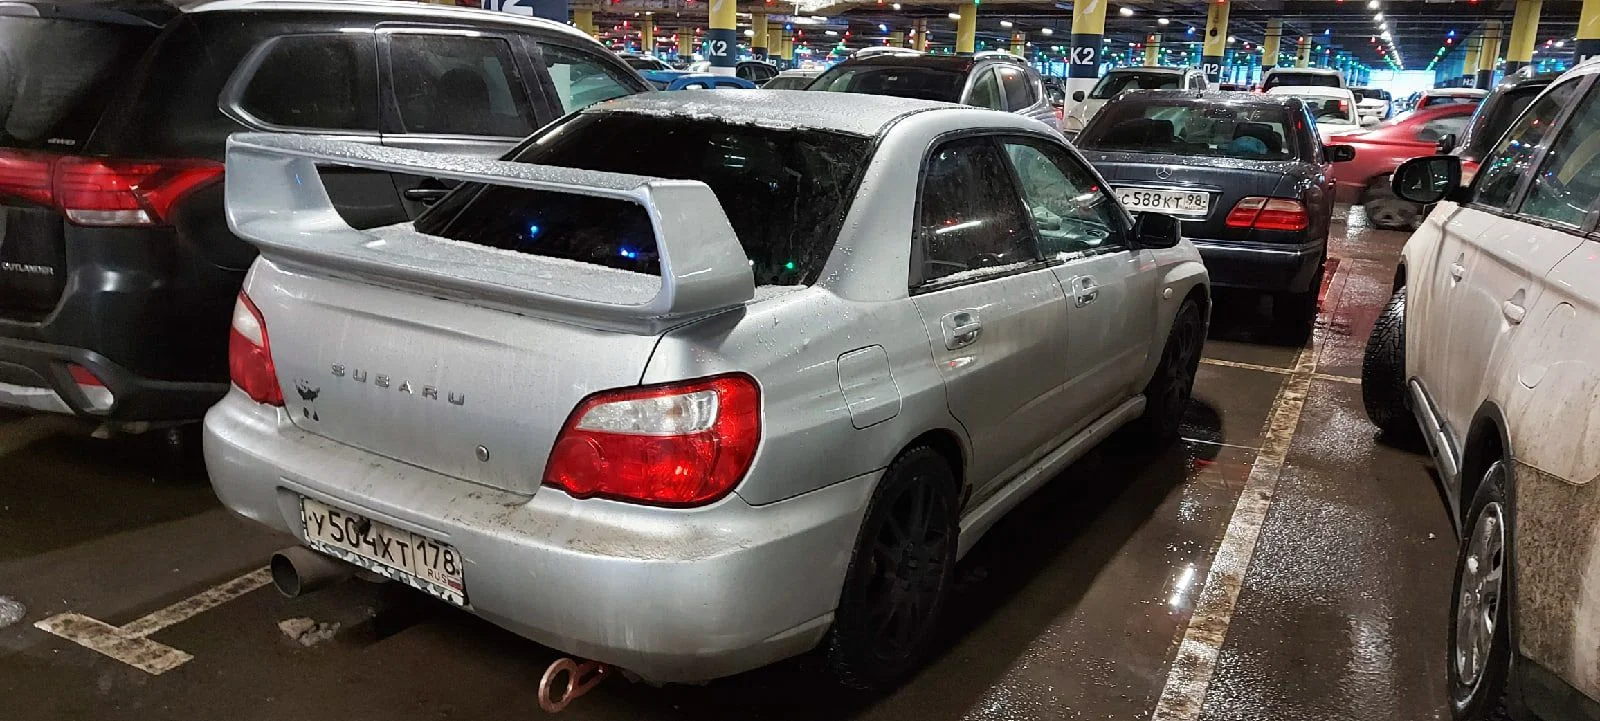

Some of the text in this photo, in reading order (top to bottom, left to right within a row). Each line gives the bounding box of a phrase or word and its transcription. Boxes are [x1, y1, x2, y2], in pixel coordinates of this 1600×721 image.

[2, 261, 55, 276] OUTLANDER
[331, 362, 466, 406] SUBARU
[416, 539, 457, 576] 178
[427, 568, 448, 585] RUS
